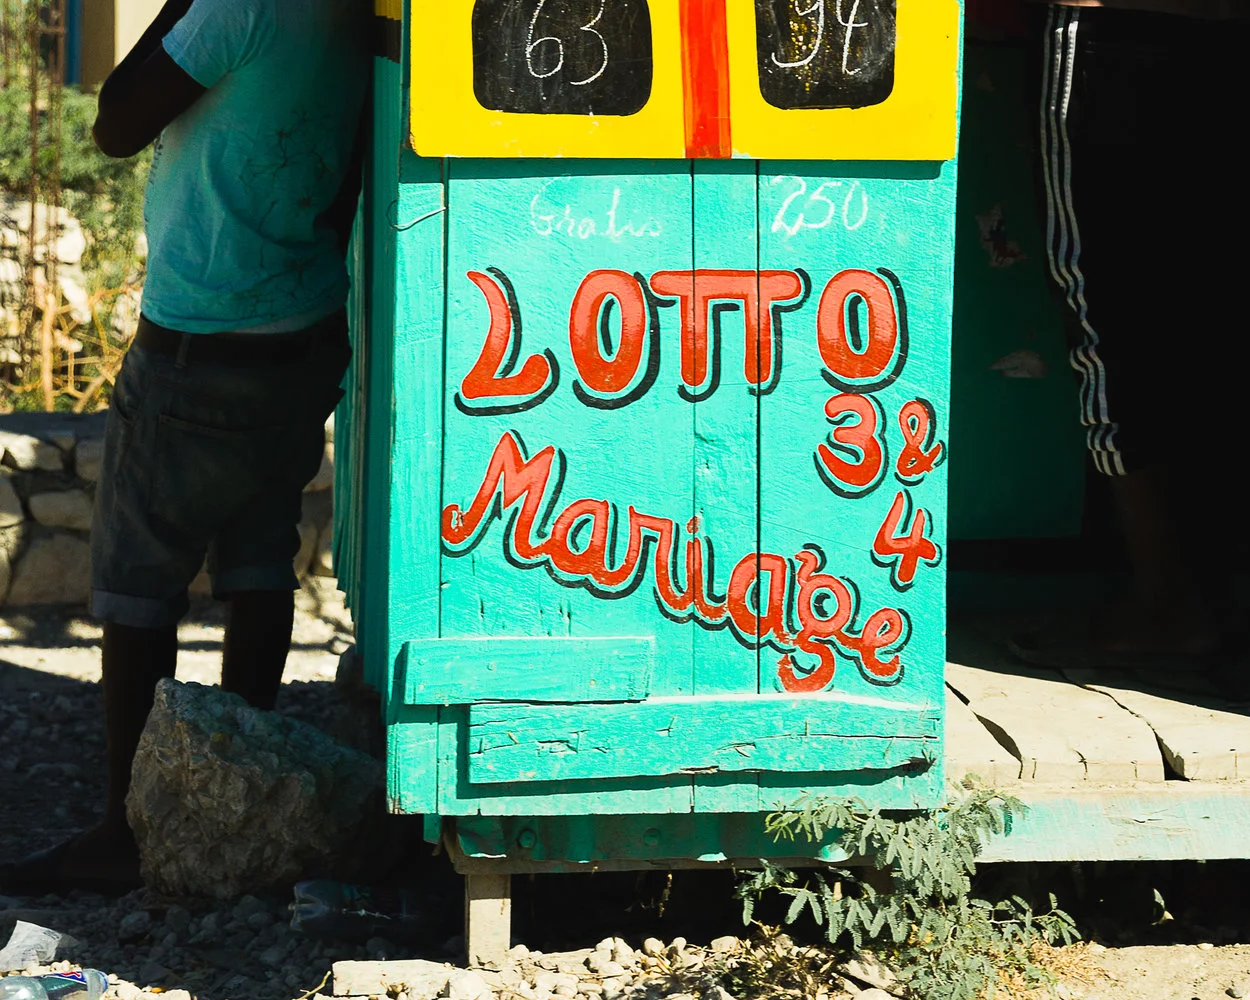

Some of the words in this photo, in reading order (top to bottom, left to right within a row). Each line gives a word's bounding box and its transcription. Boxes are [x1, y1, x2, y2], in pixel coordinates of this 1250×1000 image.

[771, 174, 869, 238] 250
[456, 266, 908, 415] LOTTO
[441, 431, 912, 693] Mariage
[871, 489, 943, 592] 4
